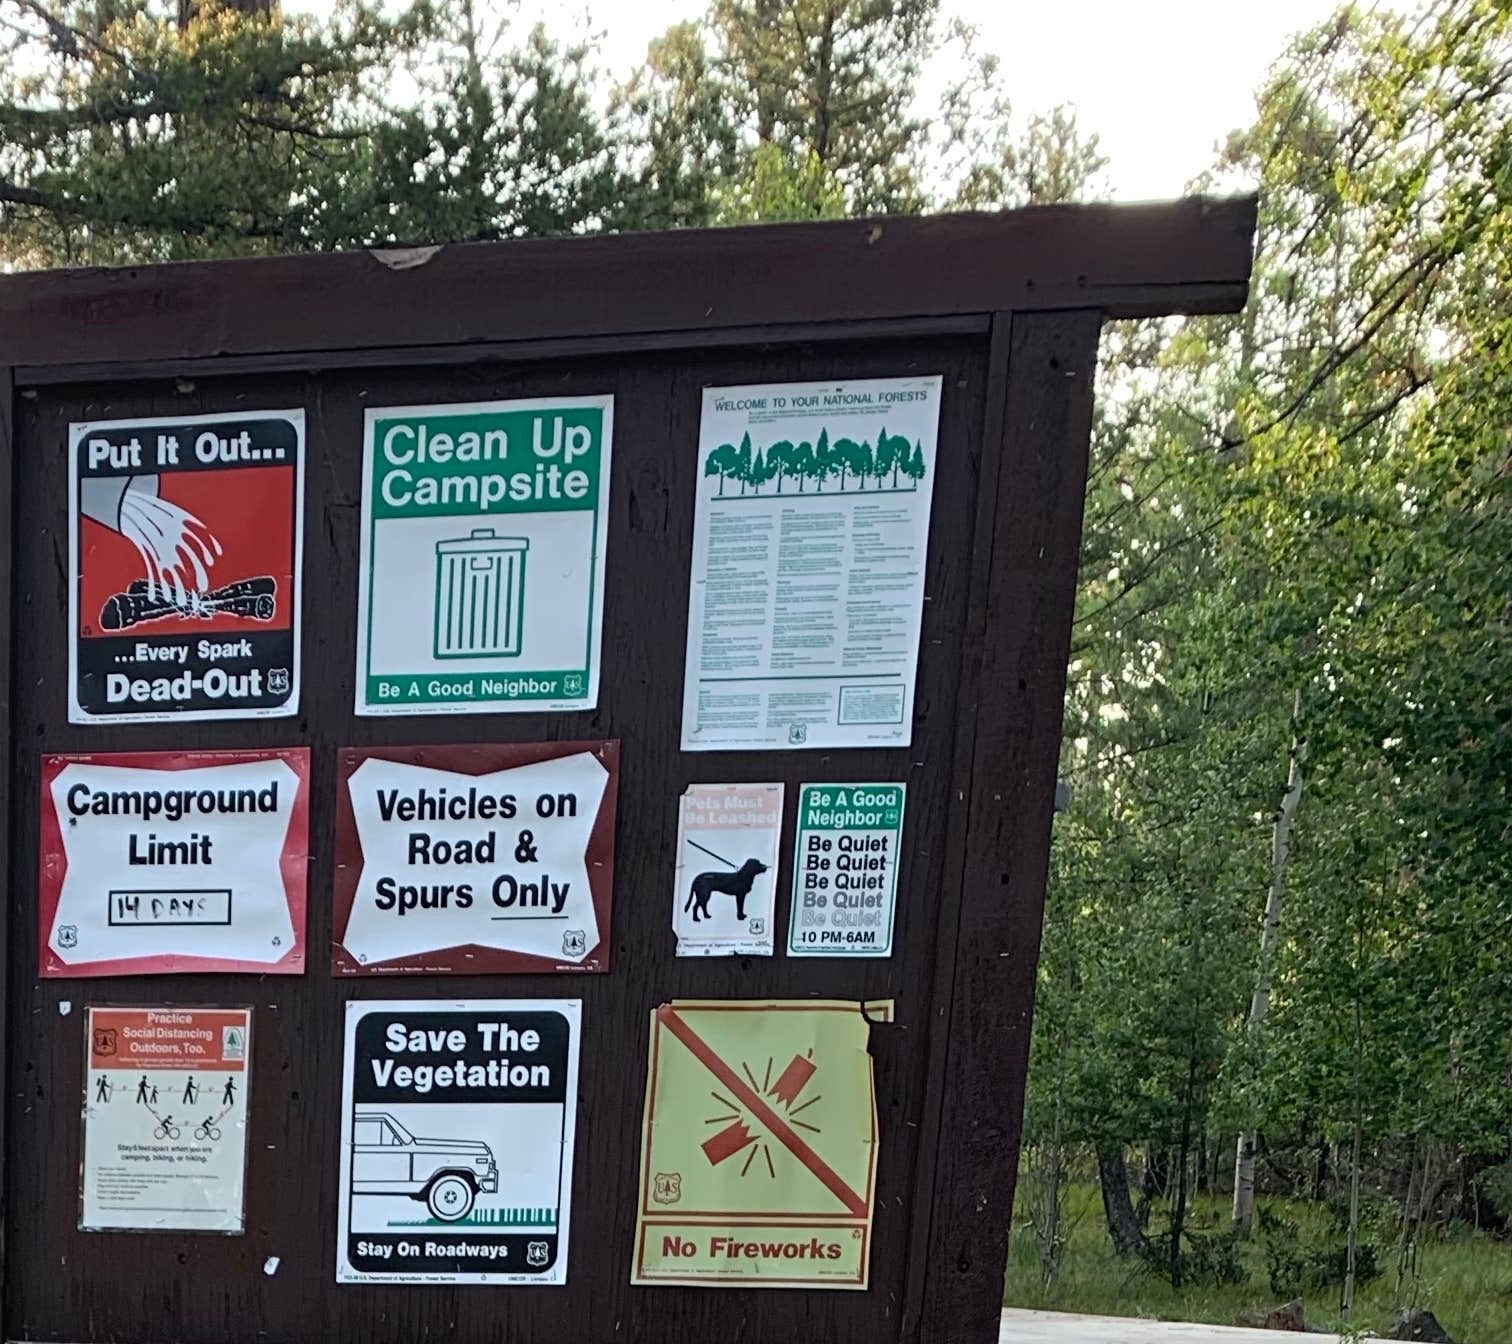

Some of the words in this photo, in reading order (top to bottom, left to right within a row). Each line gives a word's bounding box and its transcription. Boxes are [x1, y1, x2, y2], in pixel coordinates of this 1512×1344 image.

[714, 398, 767, 412] WELCOME
[773, 398, 786, 409] TO
[791, 395, 819, 407] YOUR
[823, 393, 874, 406] NATIONAL
[878, 390, 928, 402] FORESTS
[88, 437, 142, 469] Put
[157, 435, 180, 465] It
[195, 431, 286, 463] Out...
[383, 423, 509, 465] Clean
[532, 416, 592, 464] Up
[381, 463, 590, 510] Campsite
[114, 641, 189, 664] ...Every
[197, 638, 253, 660] Spark
[106, 667, 263, 703] Dead-Out
[378, 682, 401, 698] Be
[407, 681, 421, 697] A
[427, 679, 475, 697] Good
[481, 677, 558, 697] Neighbor
[66, 780, 279, 822] Campground
[376, 787, 518, 822] Vehicles
[535, 792, 578, 819] on
[686, 796, 721, 811] Pets
[809, 790, 831, 807] Be
[835, 790, 848, 807] A
[852, 789, 897, 807] Good
[808, 808, 883, 829] Neighbor
[128, 833, 213, 866] Limit
[407, 831, 496, 865] Road
[514, 829, 539, 864] &
[808, 835, 832, 852] Be
[838, 834, 888, 853] Quiet
[806, 854, 831, 871] Be
[836, 853, 886, 872] Quiet
[805, 873, 829, 889] Be
[834, 872, 885, 890] Quiet
[374, 876, 474, 916] Spurs
[492, 874, 571, 914] Only
[803, 891, 827, 908] Be
[832, 891, 883, 909] Quiet
[118, 895, 140, 920] 14
[801, 909, 826, 927] Be
[830, 909, 881, 928] Quiet
[802, 930, 817, 943] 10
[821, 930, 876, 943] PM-6AM
[147, 1012, 192, 1024] Practice
[123, 1026, 156, 1039] Social
[156, 1026, 214, 1041] Distancing
[385, 1022, 467, 1053] Save
[477, 1022, 541, 1052] The
[129, 1041, 182, 1055] Outdoors,
[183, 1042, 206, 1055] Too.
[371, 1059, 551, 1093] Vegetation
[356, 1240, 394, 1259] Stay
[397, 1241, 421, 1258] On
[424, 1241, 509, 1260] Roadways
[662, 1235, 698, 1258] No
[710, 1236, 842, 1260] Fireworks
